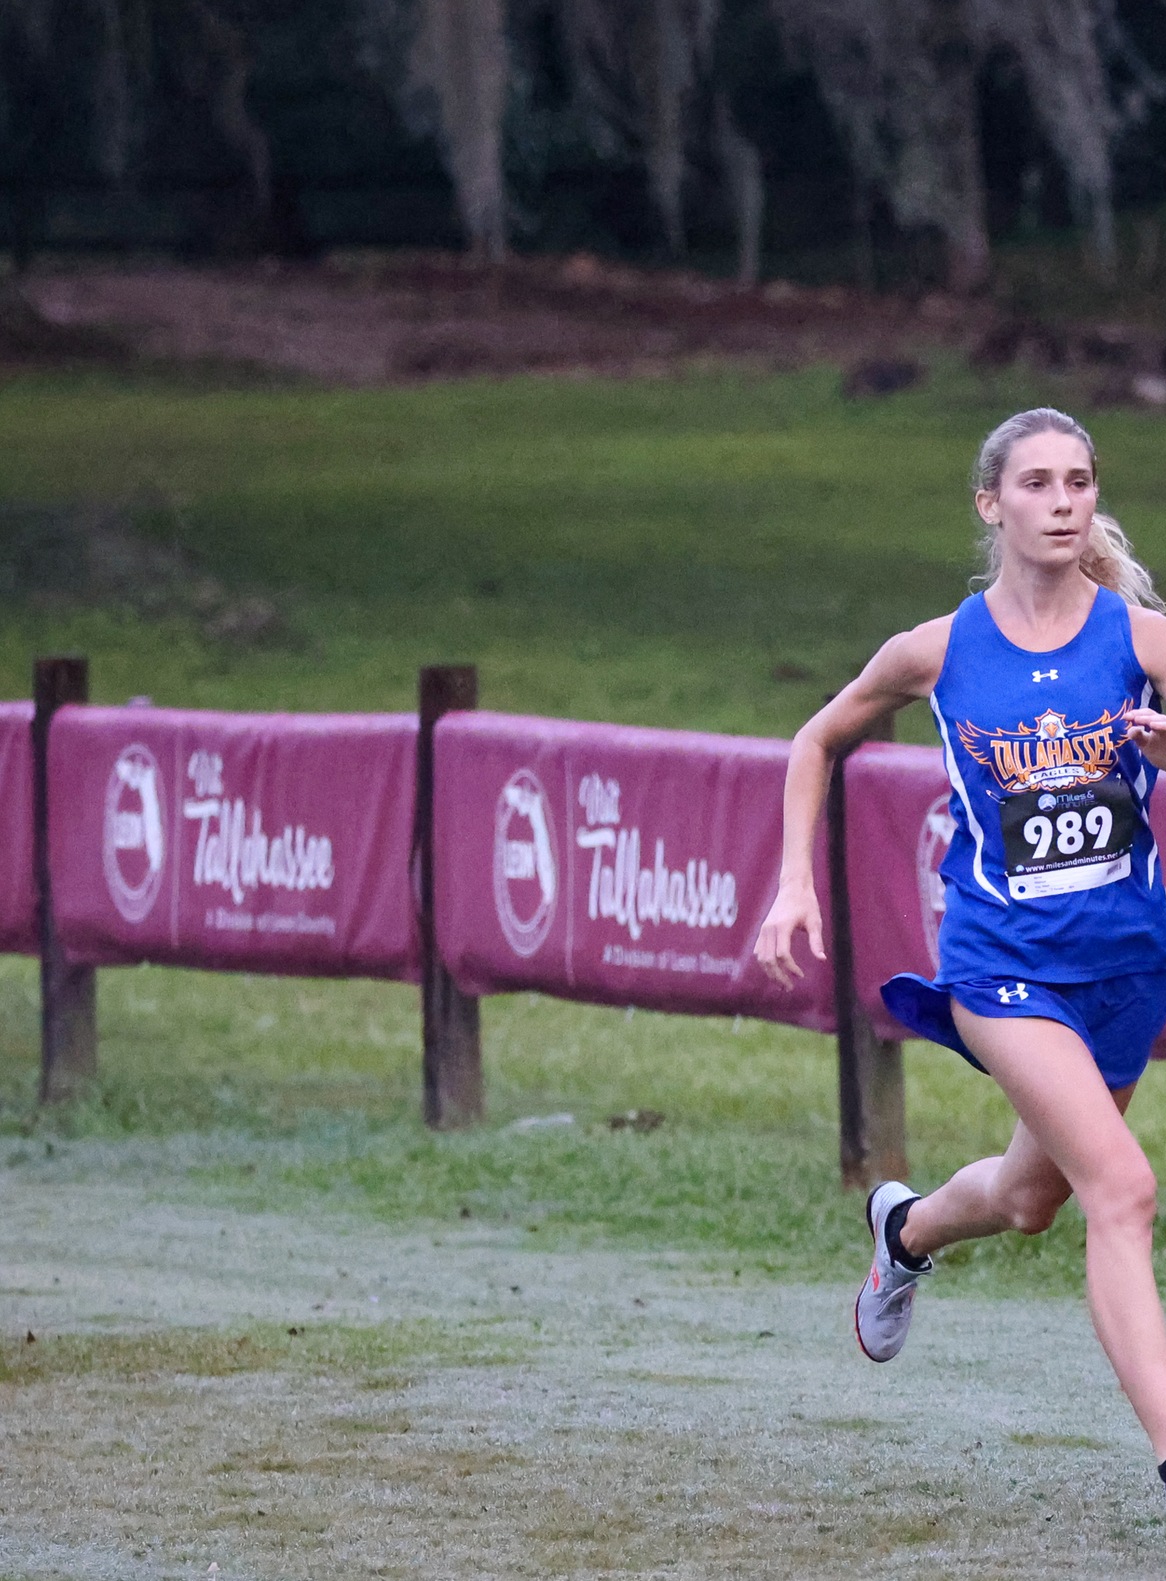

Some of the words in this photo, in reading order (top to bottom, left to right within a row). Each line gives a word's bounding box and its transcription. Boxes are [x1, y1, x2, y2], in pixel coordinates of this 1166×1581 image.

[990, 725, 1114, 780] TALLAHASSEE
[1033, 767, 1081, 780] EAGLES
[1087, 789, 1095, 799] &
[184, 798, 335, 905] Tallahassee
[1023, 805, 1113, 859] 989
[576, 826, 738, 940] Tallahassee
[1025, 852, 1118, 873] www.milesandminutes.net
